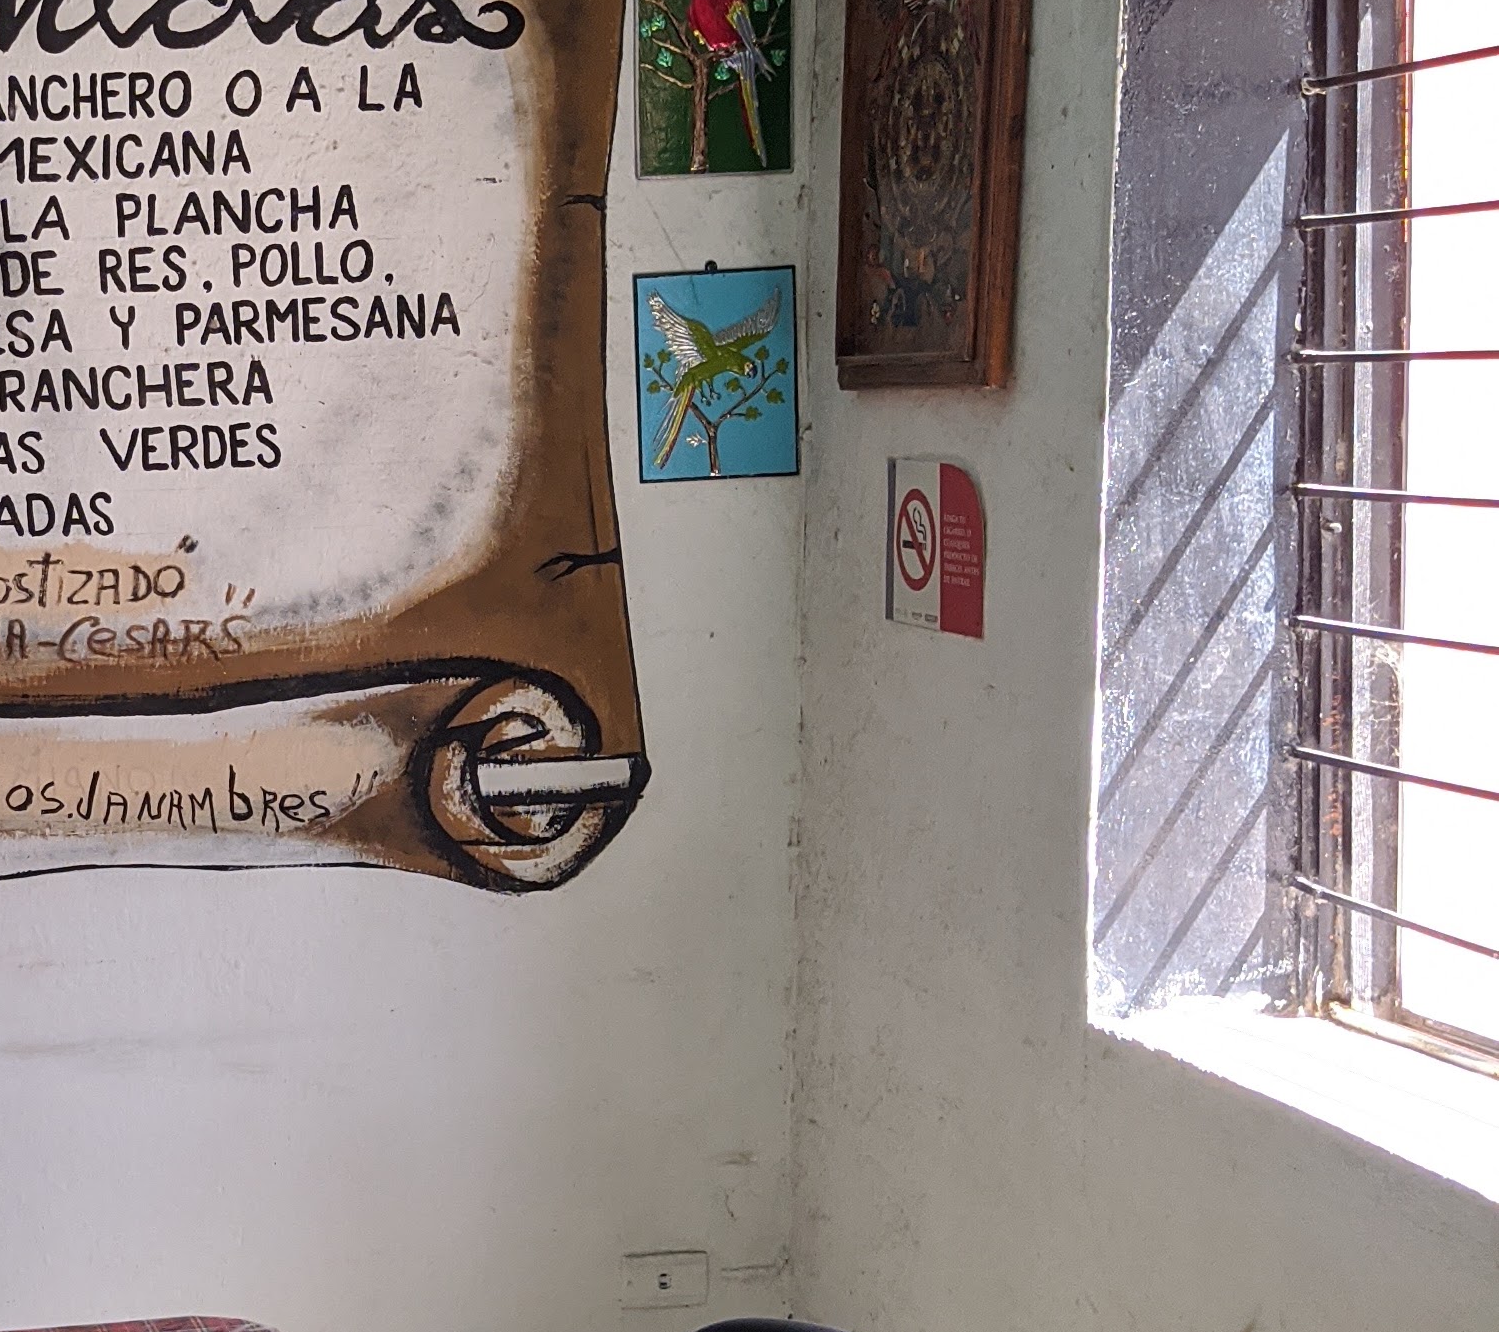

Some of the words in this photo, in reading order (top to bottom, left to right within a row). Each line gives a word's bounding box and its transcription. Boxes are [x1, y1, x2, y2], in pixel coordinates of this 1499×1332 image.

[225, 69, 262, 117] O
[286, 66, 321, 113] A
[358, 63, 423, 112] LA
[0, 195, 71, 244] LA
[116, 184, 358, 238] PLANCHA
[0, 250, 64, 298] DE
[109, 305, 136, 350] Y
[176, 292, 461, 347] PARMESANA
[100, 422, 282, 471] VERDES
